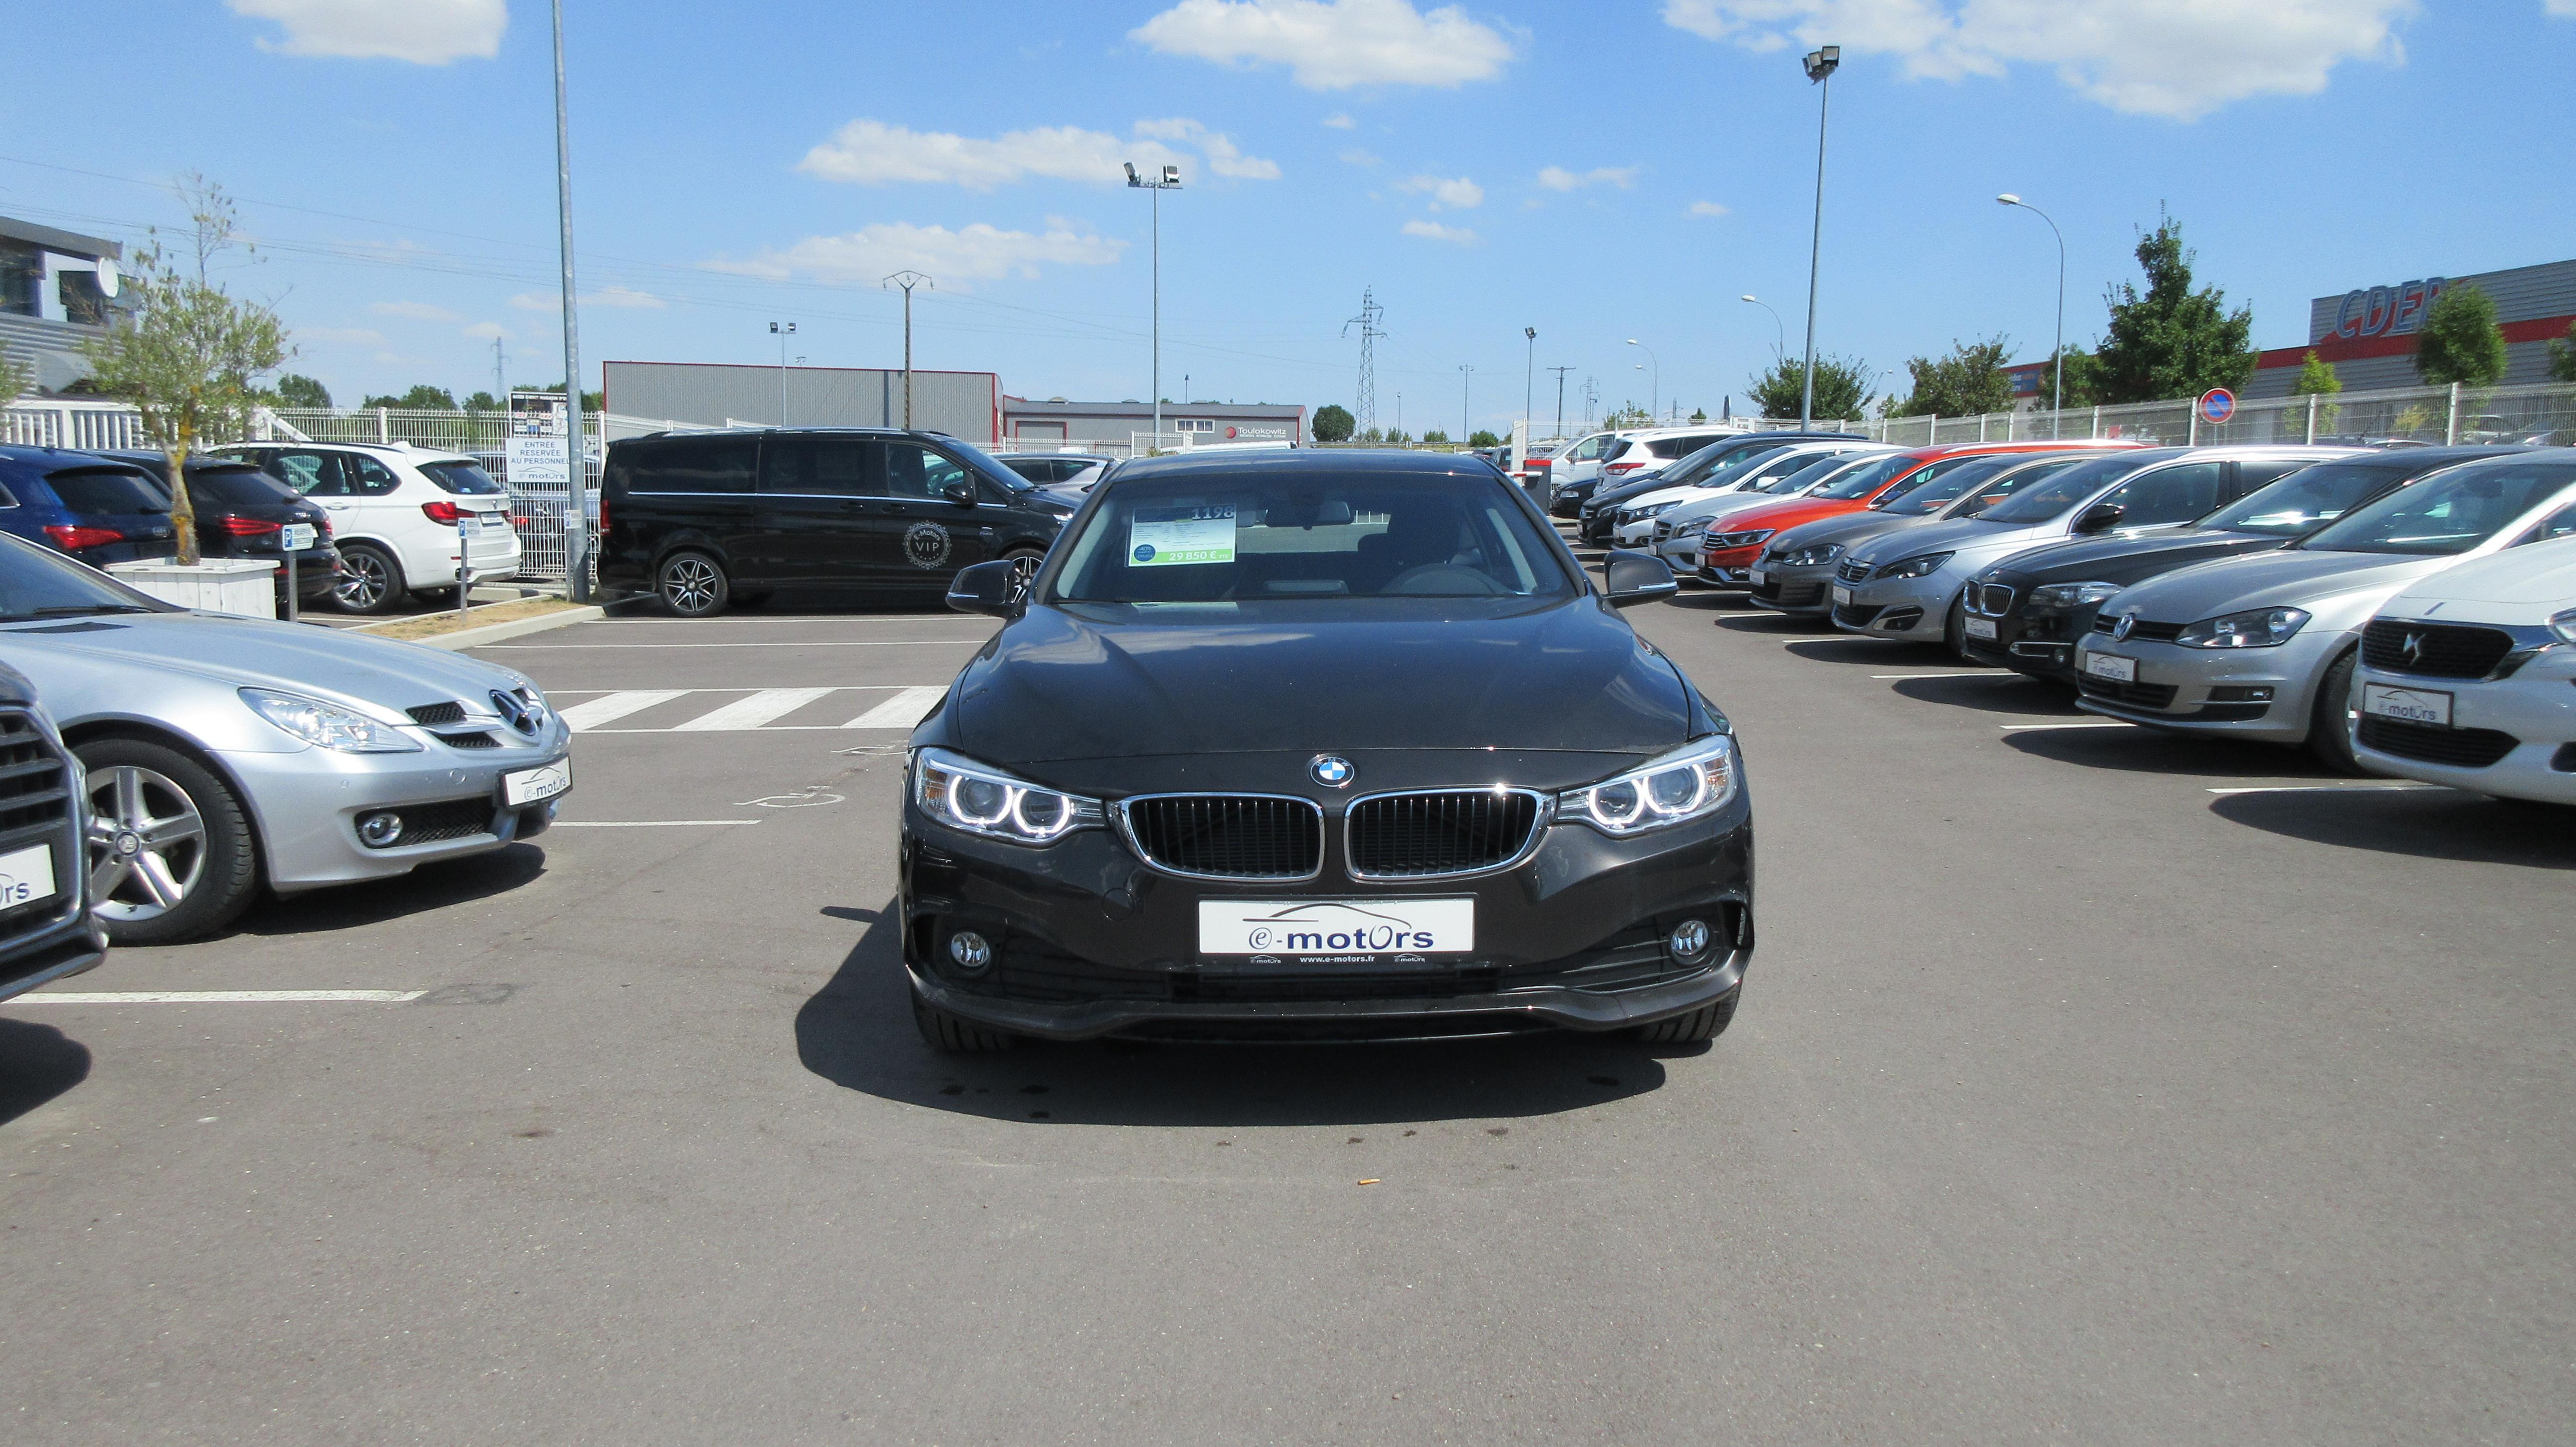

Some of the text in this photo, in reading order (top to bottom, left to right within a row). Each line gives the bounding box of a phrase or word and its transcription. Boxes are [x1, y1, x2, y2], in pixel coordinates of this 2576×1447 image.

[1192, 506, 1234, 520] 1198
[916, 542, 939, 552] VIP
[1169, 552, 1183, 561] 29
[1186, 551, 1208, 560] 850
[1209, 551, 1217, 559] €
